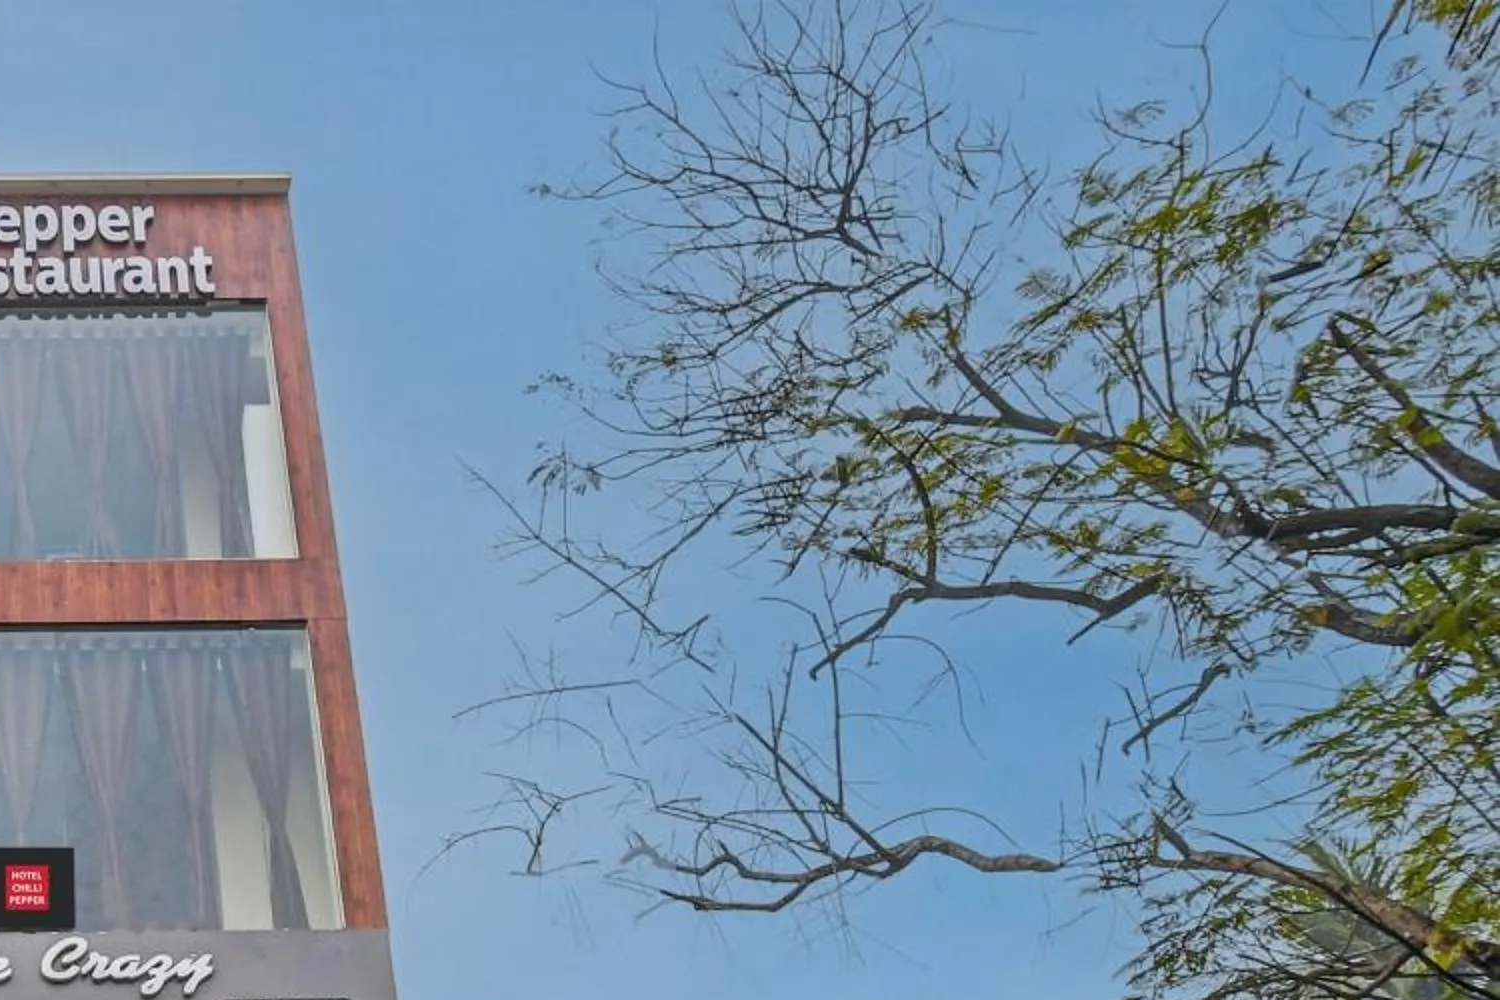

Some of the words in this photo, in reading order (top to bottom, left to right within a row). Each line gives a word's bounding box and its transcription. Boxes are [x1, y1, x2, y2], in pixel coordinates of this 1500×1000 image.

[11, 870, 42, 881] HOTEL
[11, 882, 43, 893] CHILLI
[9, 895, 45, 906] PEPPER
[40, 936, 214, 997] Crazy
